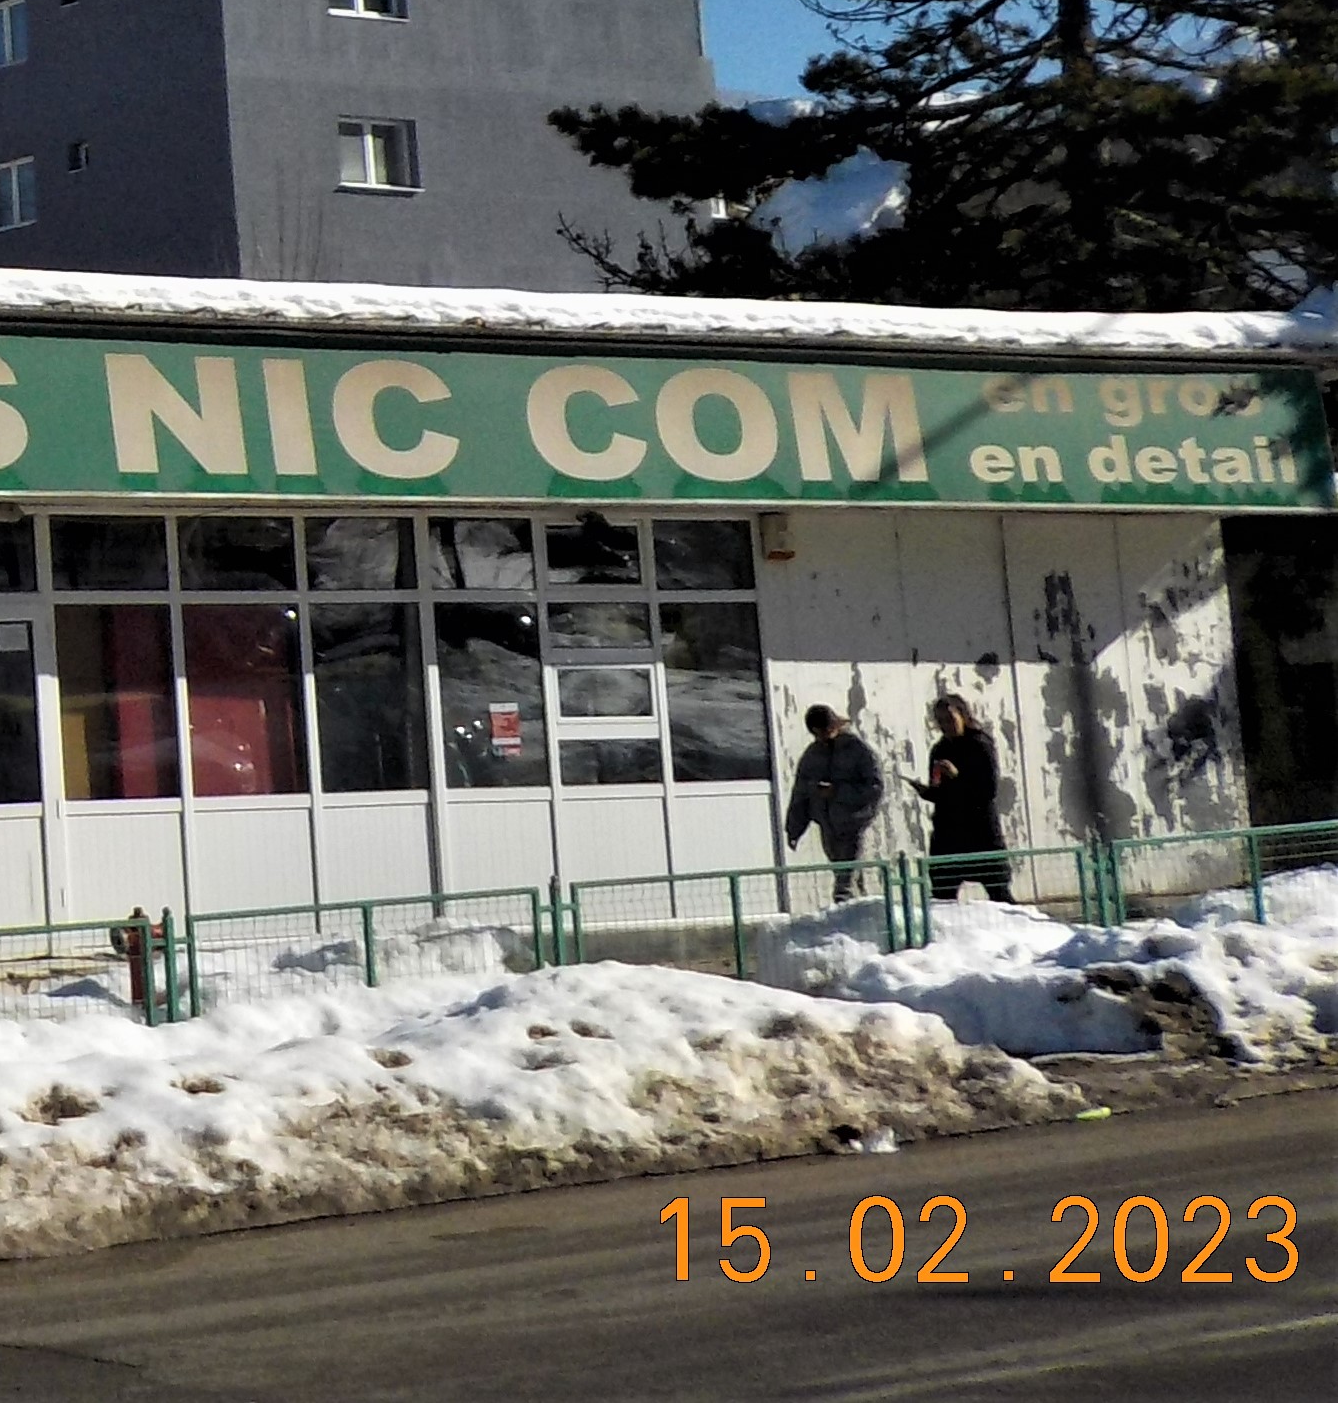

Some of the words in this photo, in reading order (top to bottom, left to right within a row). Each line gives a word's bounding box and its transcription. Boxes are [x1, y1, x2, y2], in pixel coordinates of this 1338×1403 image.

[103, 353, 460, 484] NIC
[526, 364, 928, 484] COM
[982, 376, 1075, 414] en
[969, 443, 1064, 484] en
[1087, 435, 1297, 485] detail
